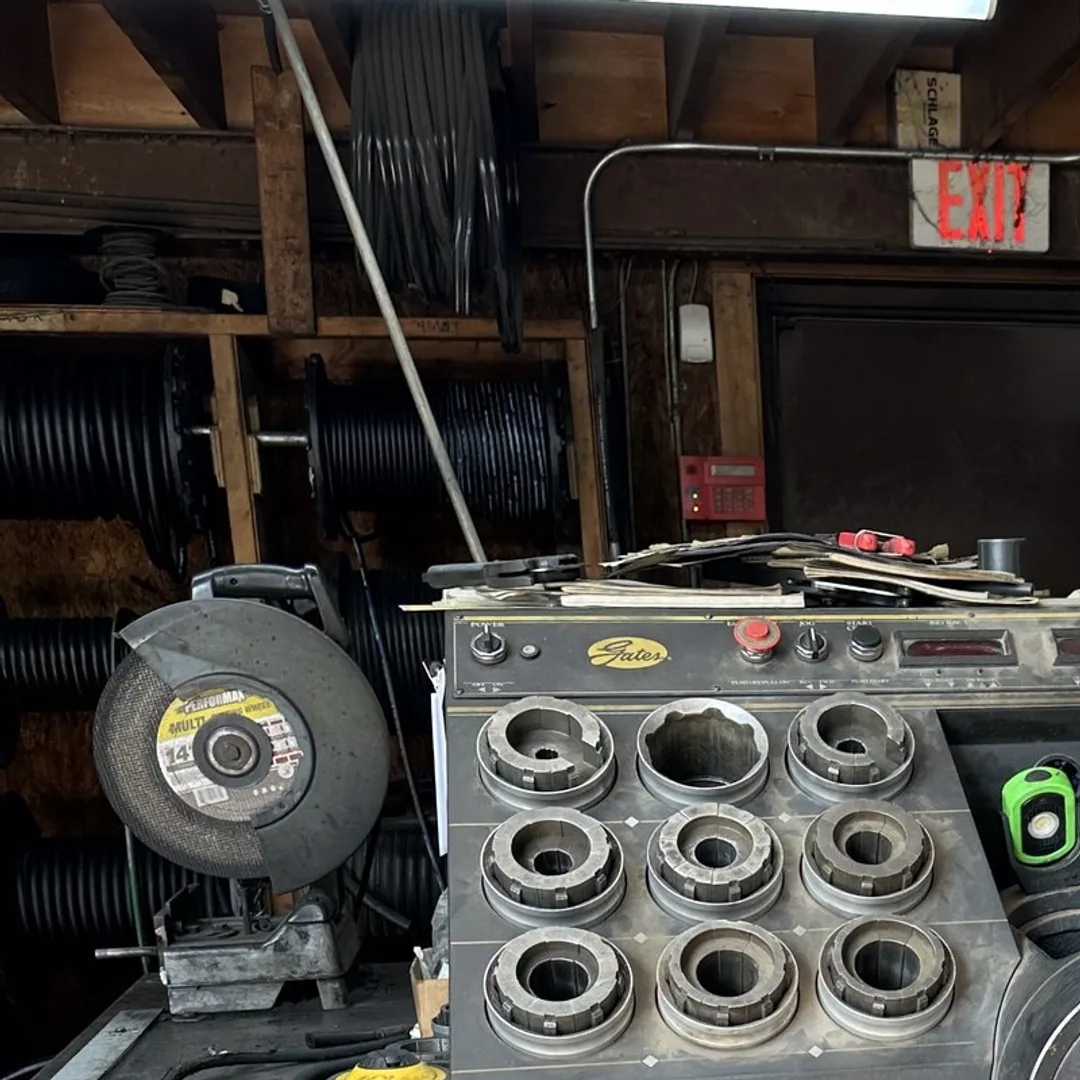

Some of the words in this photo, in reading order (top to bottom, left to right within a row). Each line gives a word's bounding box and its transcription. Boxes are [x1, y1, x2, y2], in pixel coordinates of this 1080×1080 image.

[926, 77, 939, 148] SCHLAGE
[938, 160, 1030, 243] EXIT
[588, 639, 669, 667] Gates
